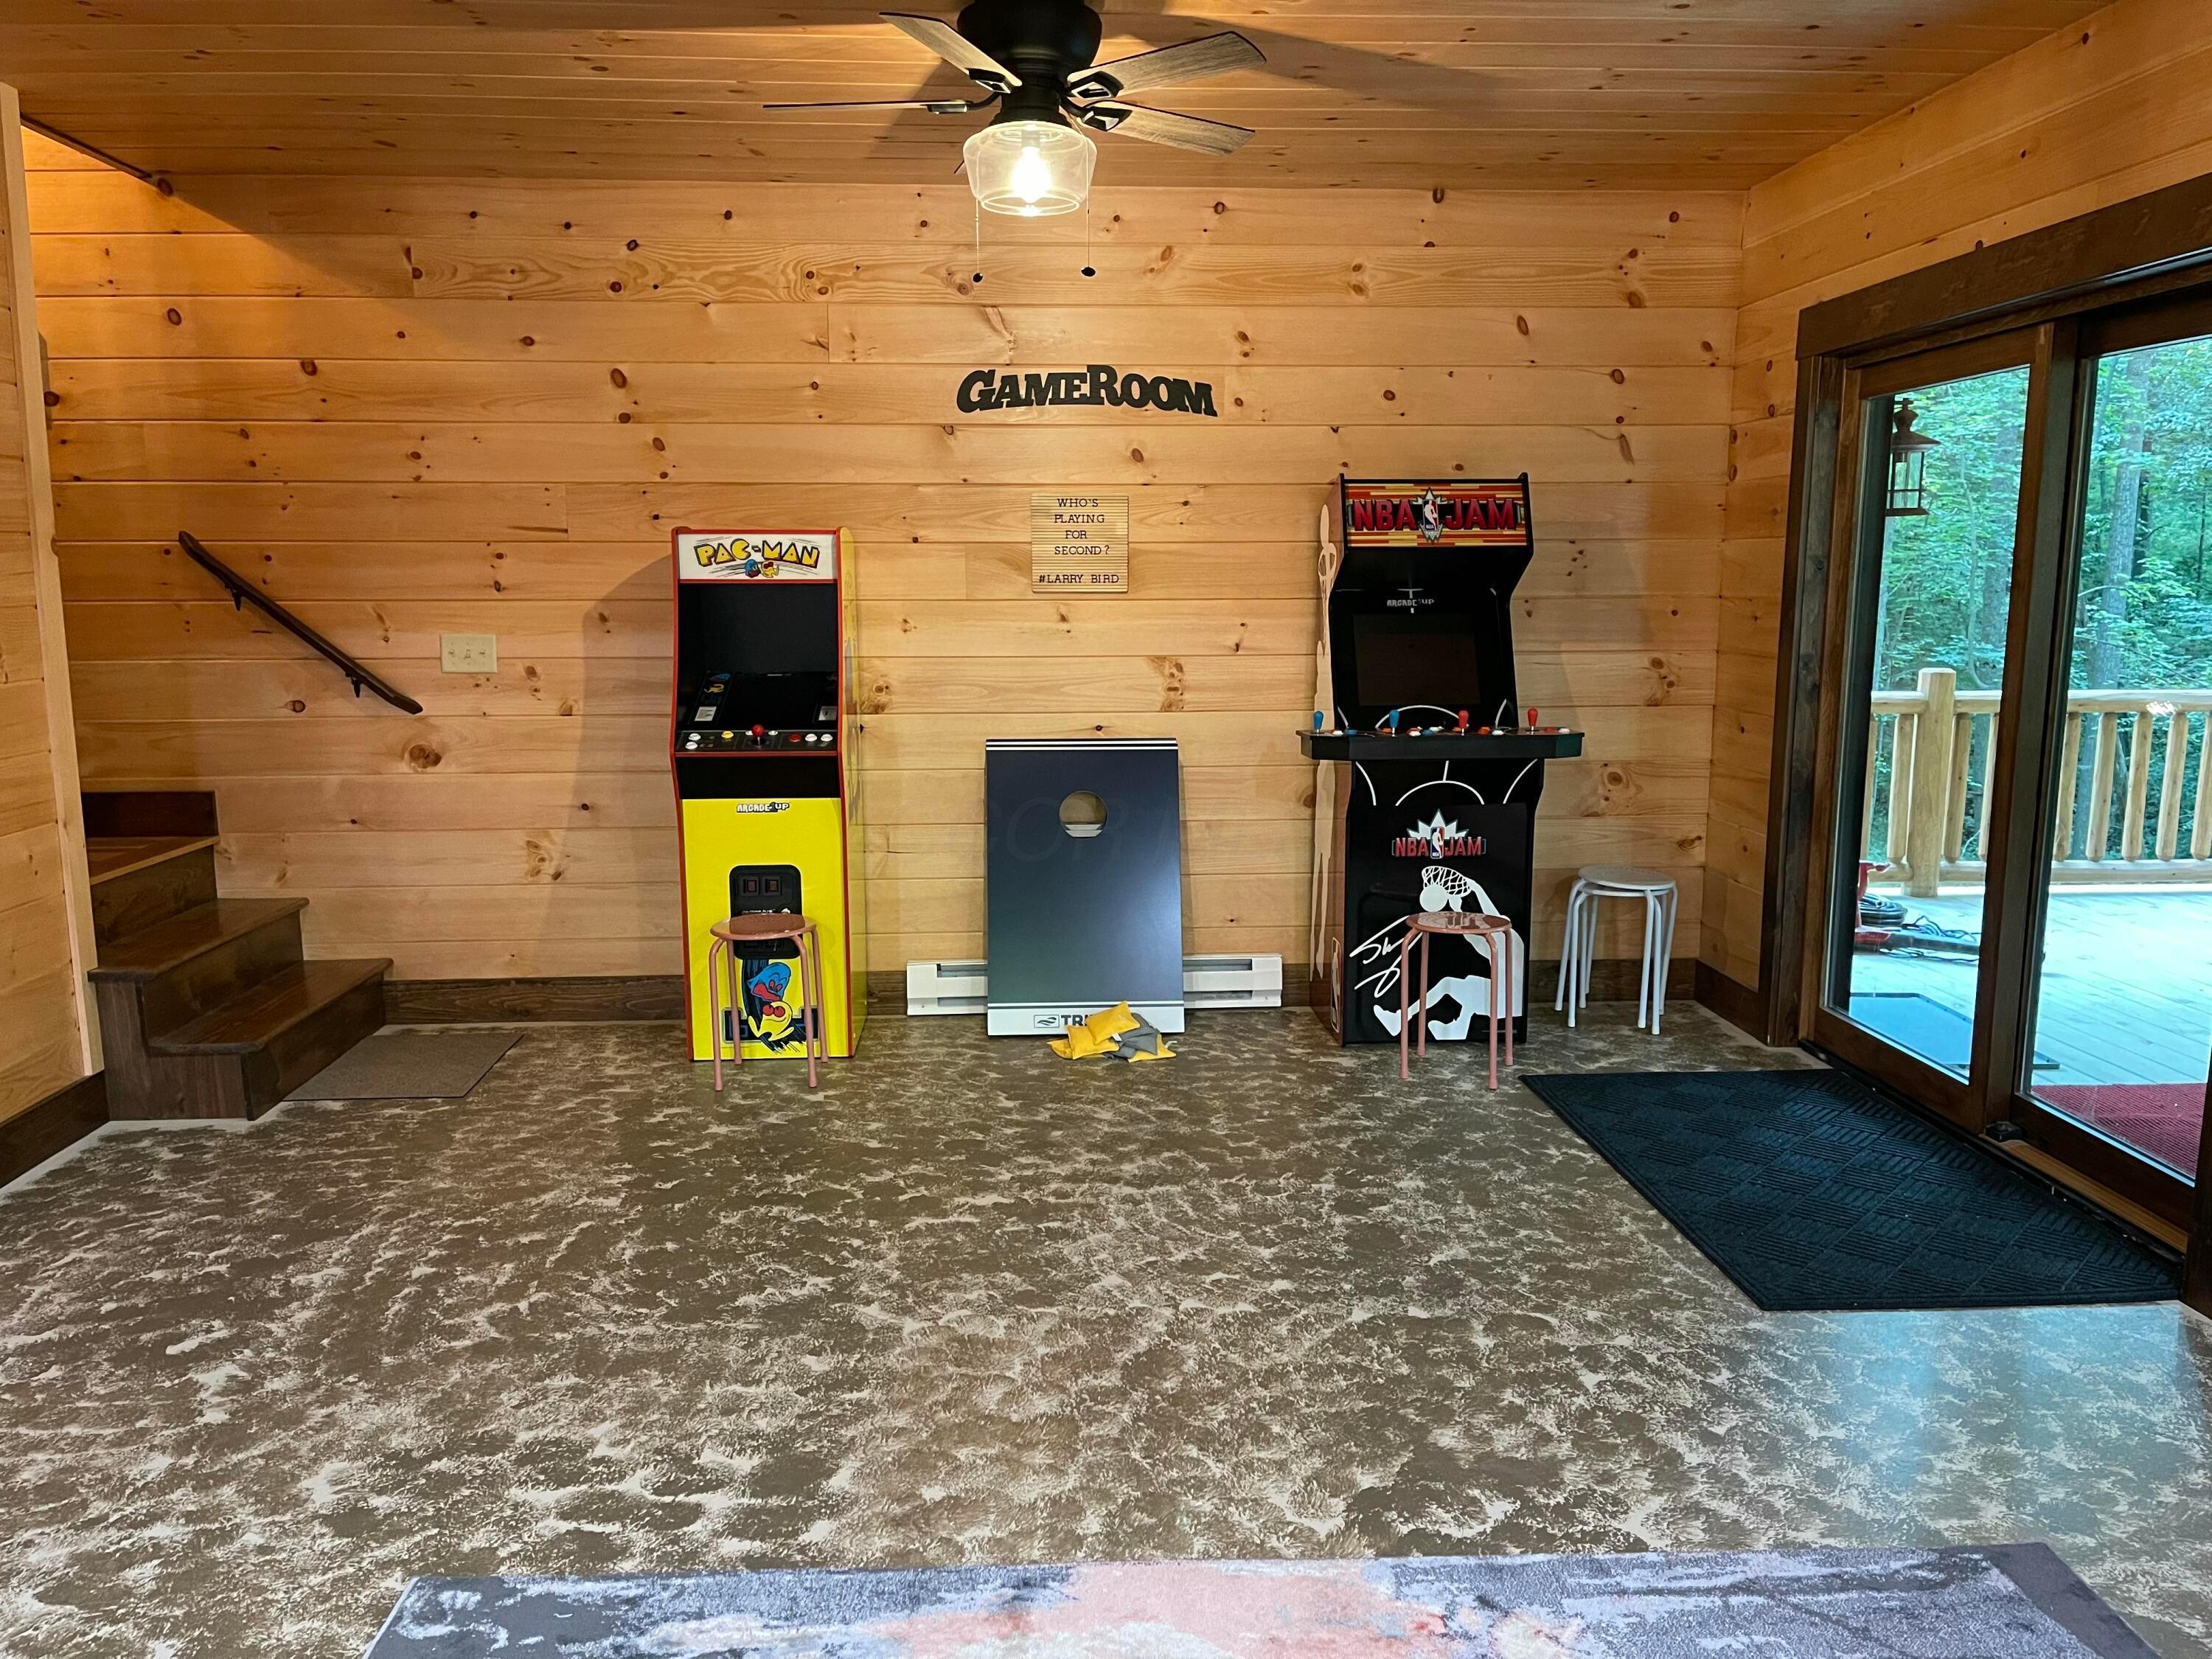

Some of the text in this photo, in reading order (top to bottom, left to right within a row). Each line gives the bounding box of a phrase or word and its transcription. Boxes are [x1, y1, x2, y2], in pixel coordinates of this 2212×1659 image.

[1057, 498, 1099, 507] WHO'S
[1054, 514, 1105, 524] PLAYING
[1353, 498, 1517, 531] NBA JAM
[1065, 530, 1088, 539] FOR
[694, 538, 820, 568] PAC-MAN
[1038, 574, 1119, 583] #LARRY BIRD
[1394, 836, 1482, 857] NBA JAM
